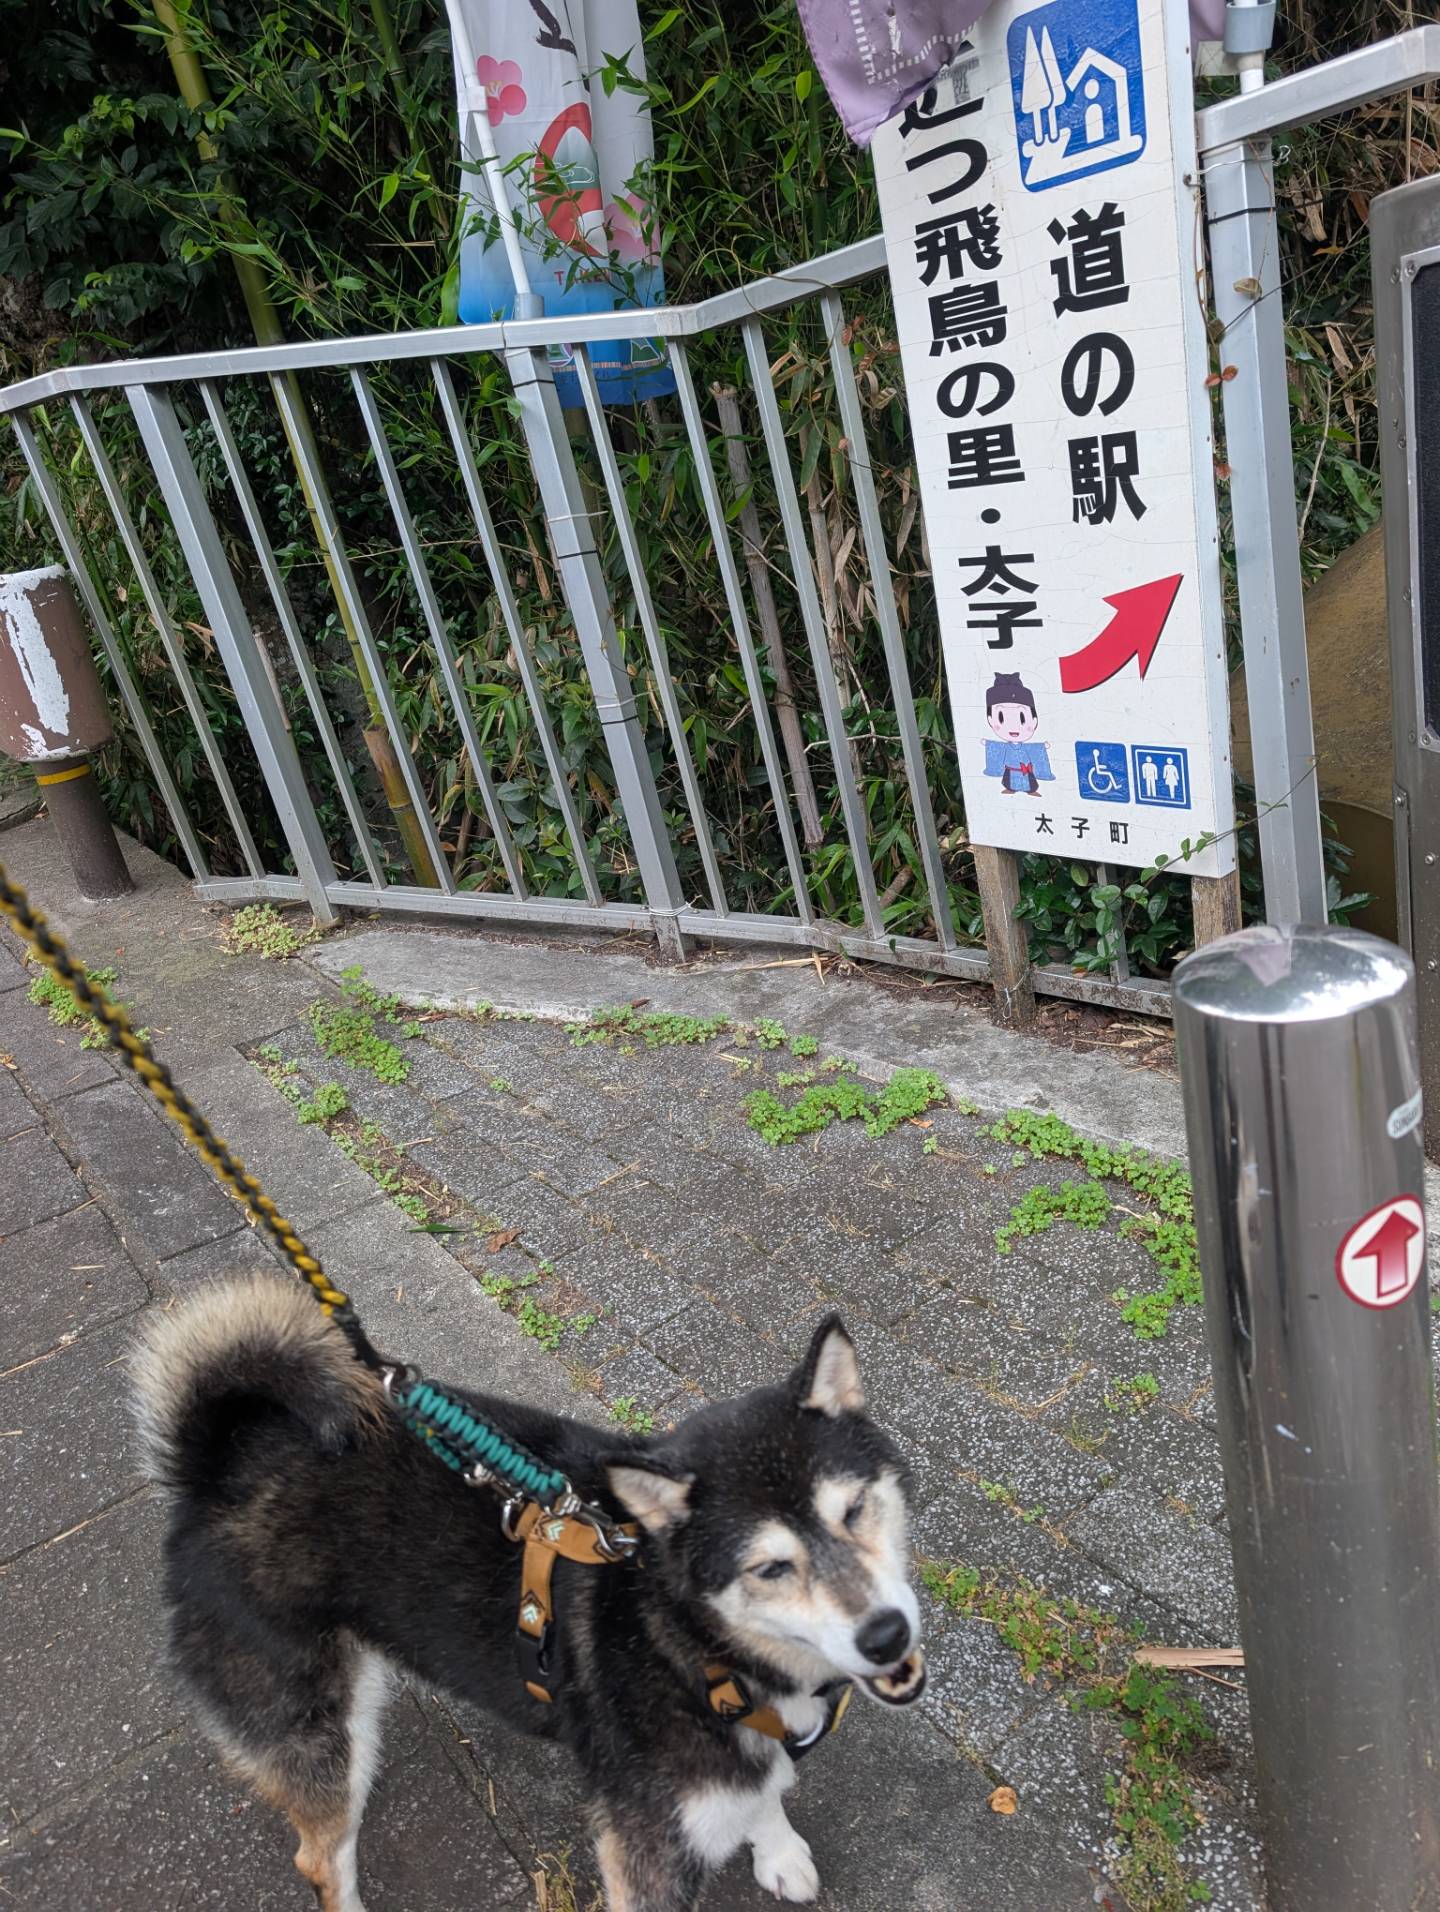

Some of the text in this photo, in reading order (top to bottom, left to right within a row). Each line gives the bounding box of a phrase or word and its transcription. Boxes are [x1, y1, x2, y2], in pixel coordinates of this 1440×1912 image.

[1047, 202, 1148, 525] 道の駅
[1034, 812, 1129, 845] 太子町
